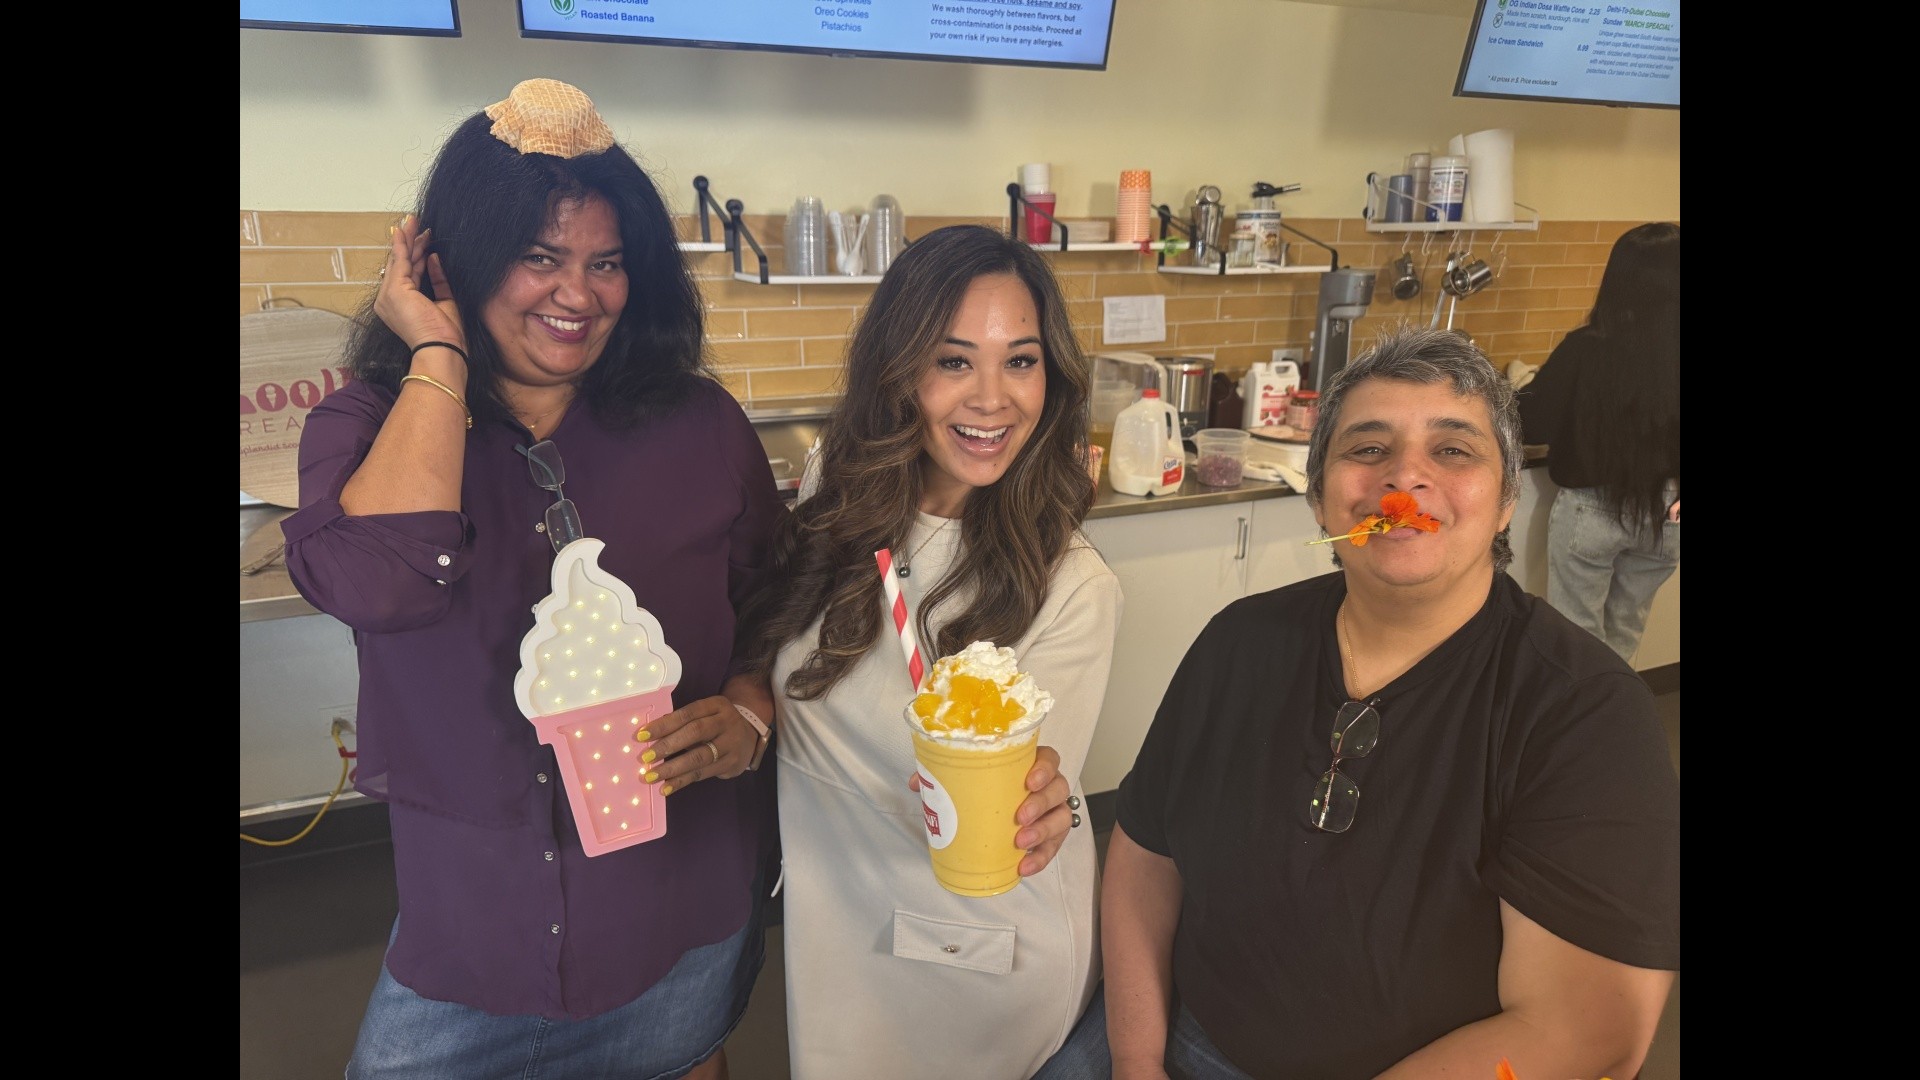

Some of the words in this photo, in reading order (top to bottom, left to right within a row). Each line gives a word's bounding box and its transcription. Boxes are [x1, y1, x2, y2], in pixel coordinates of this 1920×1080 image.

[1054, 1, 1067, 9] and
[1509, 0, 1518, 8] OG
[1520, 1, 1537, 9] Indian
[1553, 4, 1570, 13] Waffle
[1571, 6, 1585, 14] Cone
[580, 9, 619, 20] Roasted
[621, 13, 655, 23] Banana
[814, 6, 835, 16] Oreo
[837, 8, 869, 19] Cookies
[931, 4, 944, 12] We
[966, 7, 1005, 18] thoroughly
[1006, 10, 1036, 19] between
[1037, 12, 1062, 22] flavors,
[1064, 14, 1076, 22] but
[821, 21, 862, 32] Pistachios
[930, 18, 1004, 29] cross-contamination
[1013, 24, 1044, 33] possible.
[1046, 26, 1074, 35] Proceed
[929, 32, 946, 40] your
[965, 33, 978, 41] risk
[1019, 38, 1031, 46] any
[1033, 39, 1063, 48] allergies.
[1488, 36, 1497, 44] Ice
[1497, 37, 1516, 46] Cream
[1517, 38, 1544, 48] Sandwich
